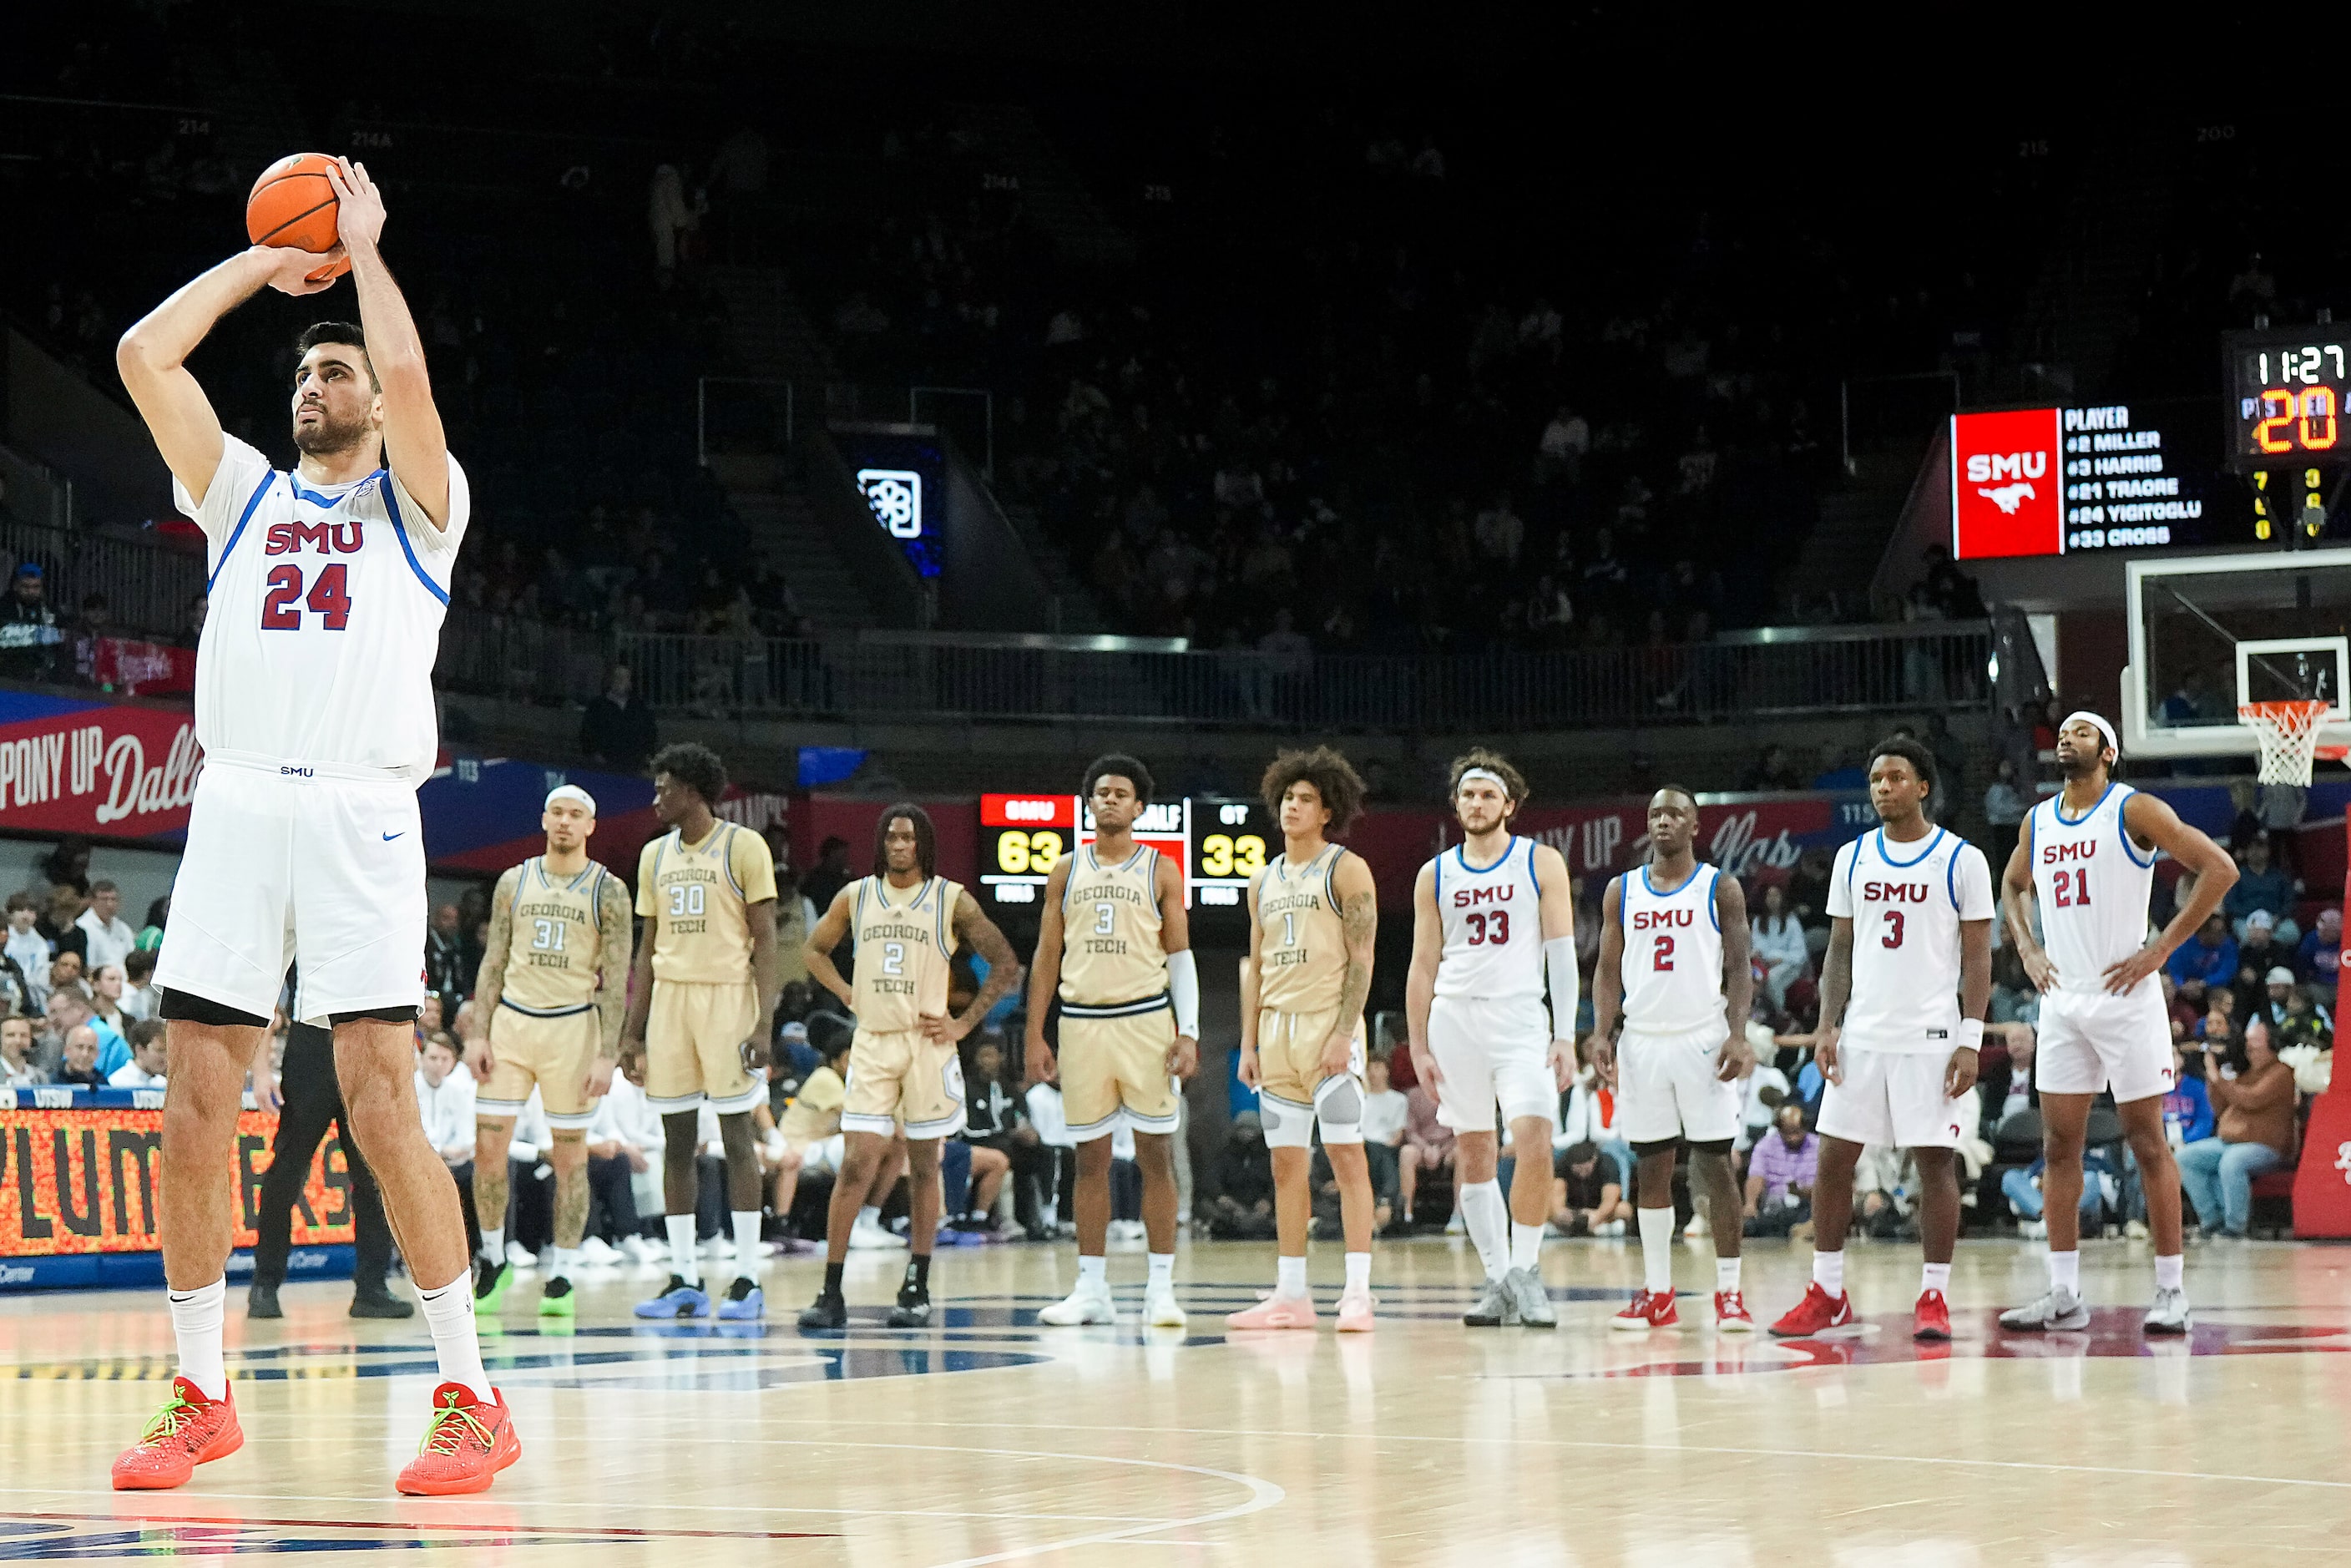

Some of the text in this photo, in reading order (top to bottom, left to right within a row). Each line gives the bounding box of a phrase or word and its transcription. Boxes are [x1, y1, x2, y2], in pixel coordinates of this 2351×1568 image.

[2259, 344, 2345, 385] 11:27
[2065, 406, 2129, 432] PLAYER
[2260, 386, 2337, 453] 20
[2094, 431, 2161, 452] MILLER
[1967, 451, 2046, 483] SMU
[2095, 454, 2163, 476] HARRIS
[2106, 478, 2179, 498] TRAORE
[265, 520, 364, 556] SMU
[260, 563, 352, 631] 24
[0, 722, 205, 825] PONY UP Dall
[281, 766, 314, 777] SMU
[1004, 799, 1054, 821] SMU
[997, 830, 1063, 874] 63
[1201, 833, 1267, 877] 33
[2044, 838, 2097, 865] SMU
[660, 867, 718, 888] GEORGIA
[2054, 867, 2091, 908] 21
[669, 884, 707, 916] 30
[1073, 885, 1141, 906] GEORGIA
[1454, 883, 1514, 909] SMU
[1864, 881, 1929, 903] SMU
[519, 903, 586, 924] GEORGIA
[1261, 893, 1321, 918] GEORGIA
[669, 919, 706, 934] TECH
[1094, 903, 1115, 935] 3
[1282, 912, 1295, 947] 1
[1465, 910, 1509, 945] 33
[1633, 908, 1694, 931] SMU
[1882, 910, 1904, 949] 3
[532, 918, 567, 952] 31
[862, 923, 929, 946] GEORGIA
[1084, 939, 1127, 954] TECH
[528, 951, 569, 969] TECH
[882, 942, 905, 975] 2
[1273, 948, 1307, 966] TECH
[1653, 934, 1675, 972] 2
[872, 978, 915, 996] TECH
